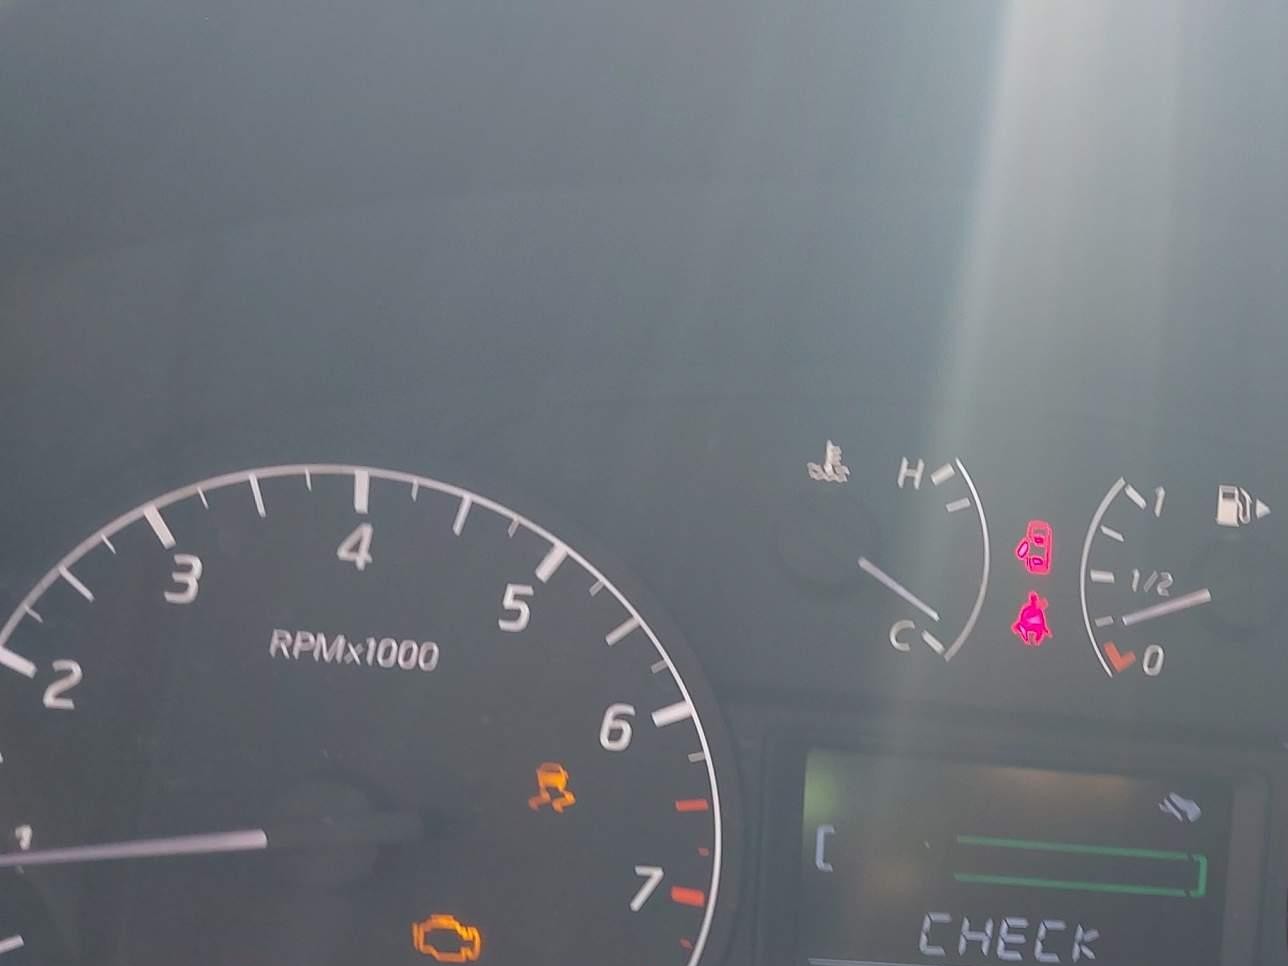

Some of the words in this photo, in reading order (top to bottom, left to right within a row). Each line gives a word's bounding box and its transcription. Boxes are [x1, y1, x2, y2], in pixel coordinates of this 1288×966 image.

[898, 458, 924, 489] H
[1155, 487, 1165, 516] 1
[338, 524, 372, 570] 4
[165, 555, 202, 602] 3
[1132, 569, 1173, 595] 1/2
[499, 584, 533, 630] 5
[890, 621, 915, 650] C
[1143, 646, 1163, 675] 0
[43, 660, 82, 708] 2
[600, 705, 635, 750] 6
[631, 867, 663, 910] 7
[919, 911, 1099, 963] CHECK
